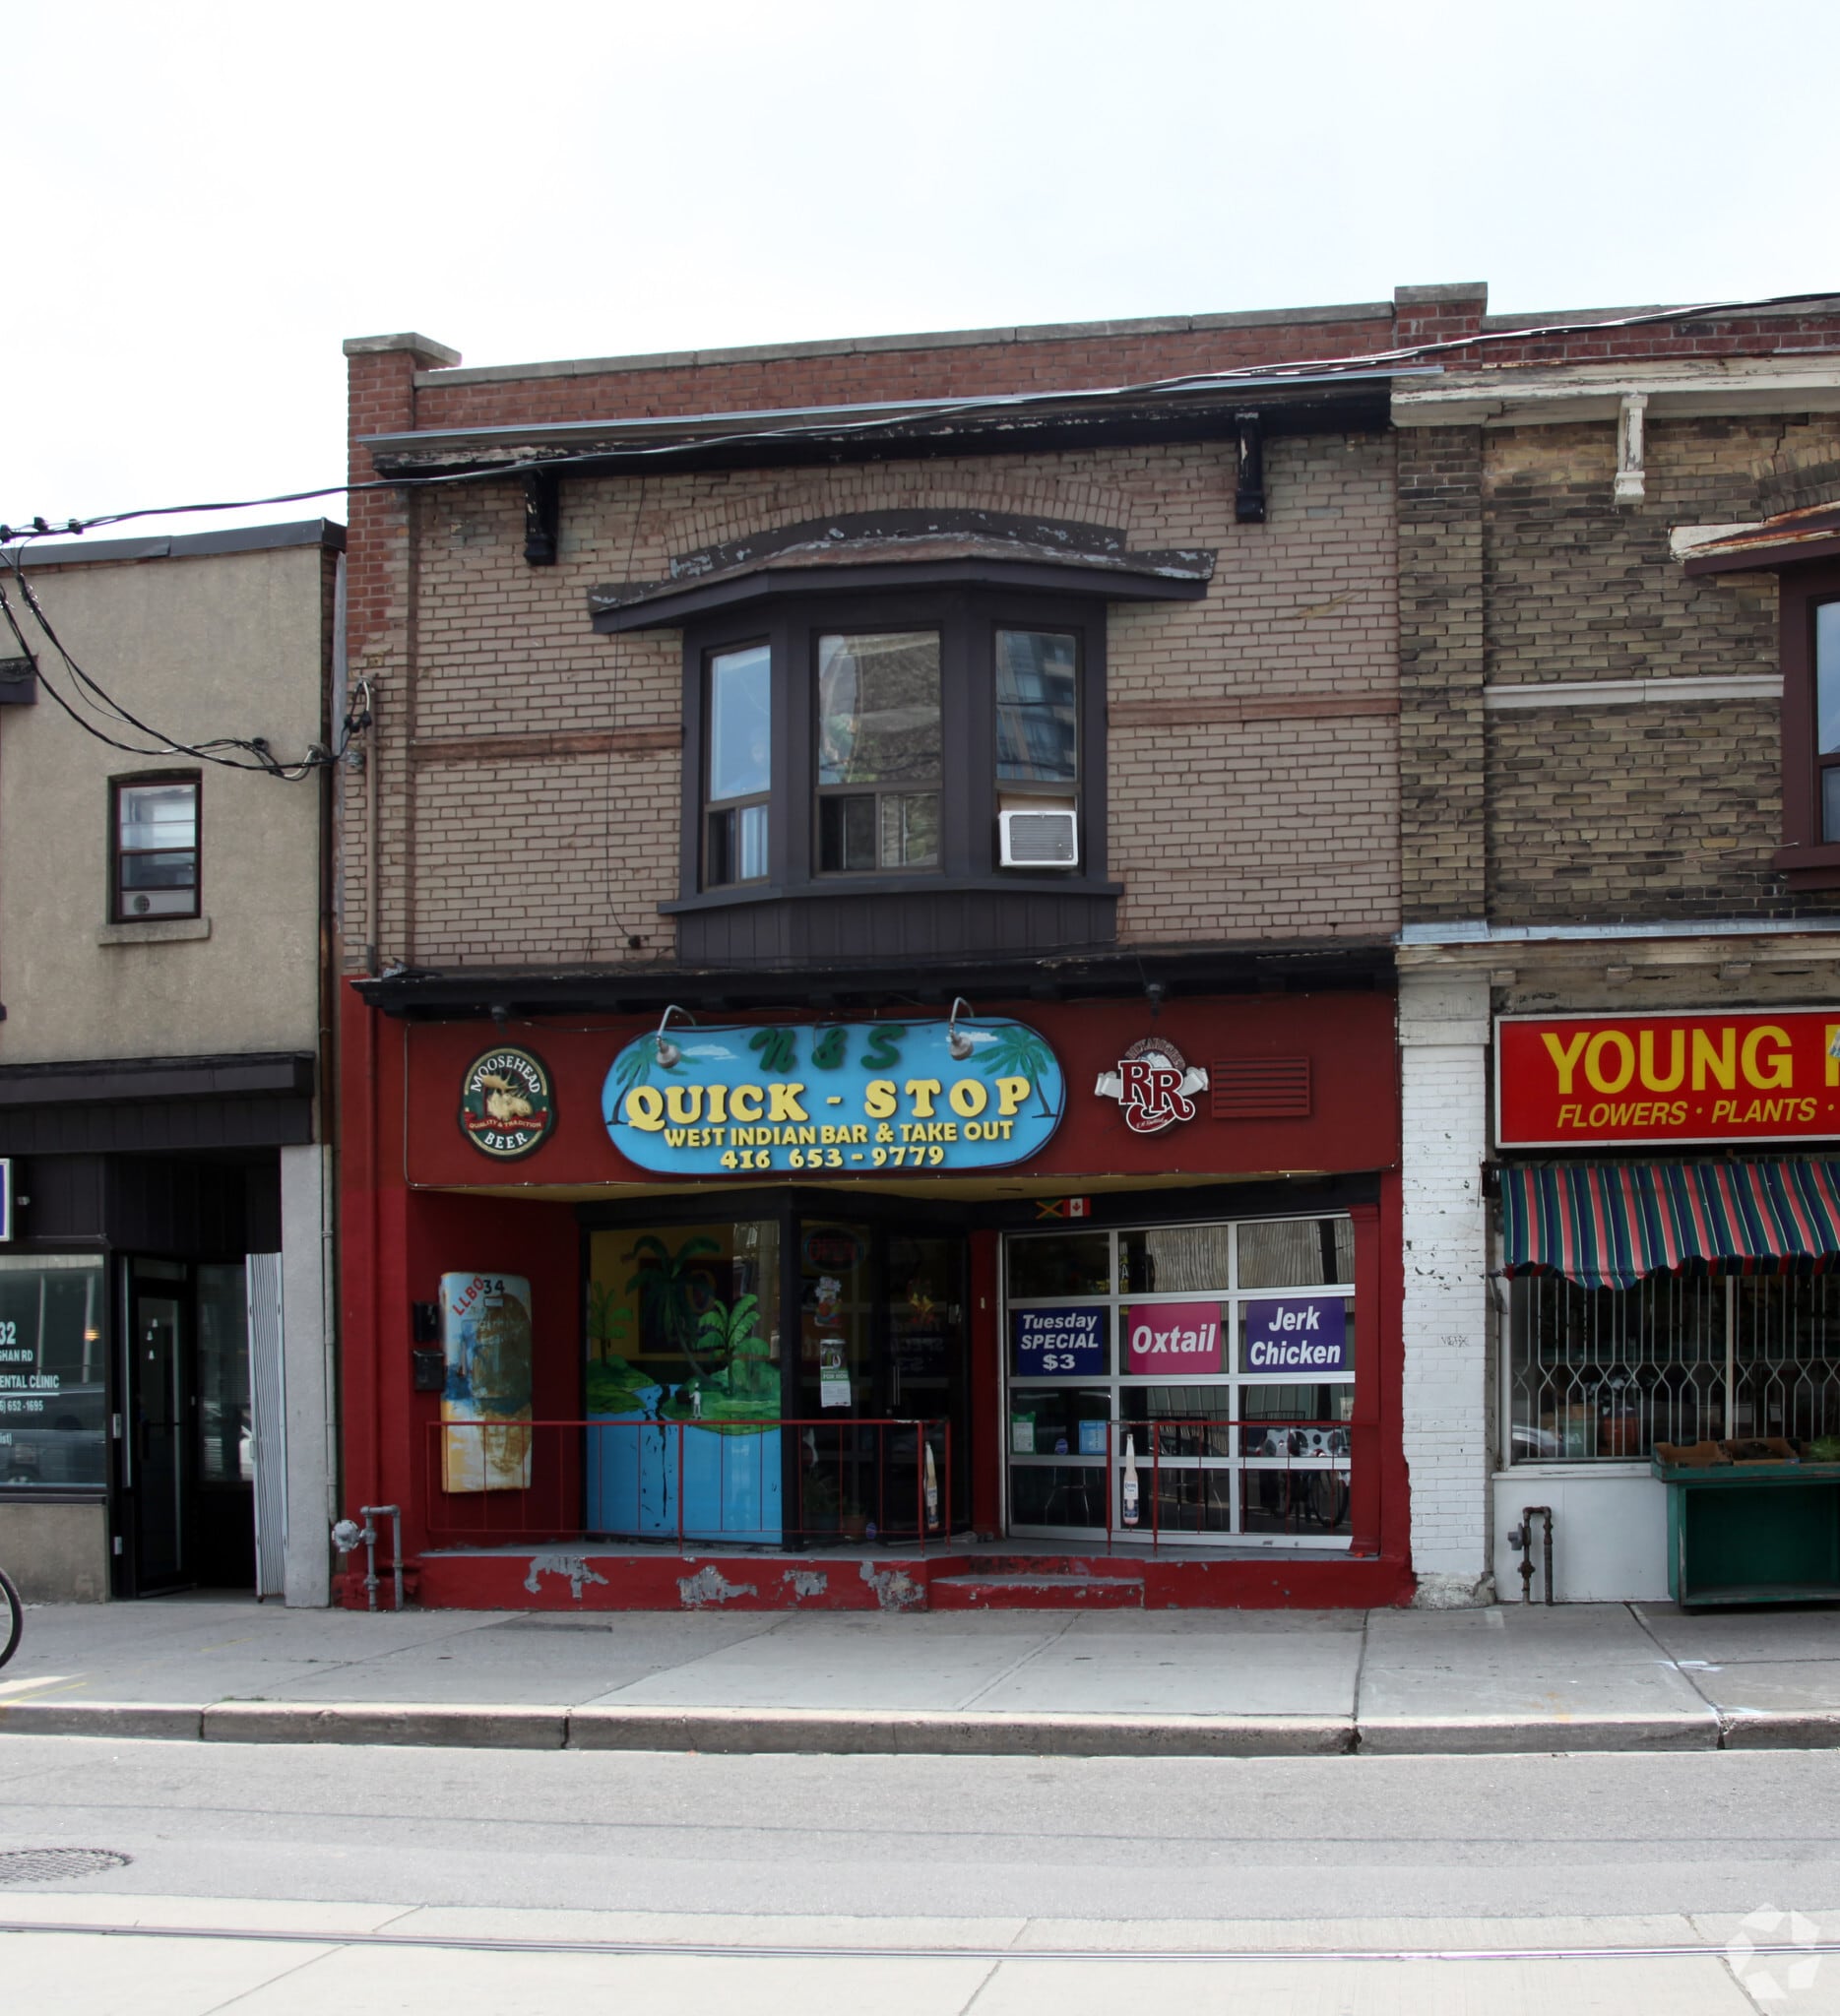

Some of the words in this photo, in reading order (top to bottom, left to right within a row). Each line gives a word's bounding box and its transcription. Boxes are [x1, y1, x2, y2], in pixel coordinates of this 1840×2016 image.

[811, 1027, 848, 1070] &
[860, 1025, 906, 1070] S
[1541, 1025, 1794, 1095] YOUNG
[470, 1055, 541, 1093] MOOSEHEAD
[625, 1083, 809, 1132] QUICK
[864, 1076, 1031, 1119] STOP
[1556, 1100, 1688, 1128] FLOWERS
[1711, 1097, 1817, 1124] PLANTS
[483, 1131, 528, 1150] BEER
[664, 1127, 726, 1148] WEST
[730, 1126, 816, 1146] INDIAN
[820, 1124, 868, 1144] BAR
[874, 1122, 894, 1143] &
[899, 1122, 957, 1142] TAKE
[963, 1120, 1014, 1141] OUT
[720, 1149, 772, 1169] 416
[789, 1147, 844, 1168] 653
[871, 1145, 945, 1166] 9779
[453, 1276, 483, 1315] LLBO
[483, 1280, 504, 1293] 34
[1022, 1313, 1098, 1331] Tuesday
[1269, 1306, 1321, 1332] Jerk
[1020, 1333, 1099, 1350] SPECIAL
[1132, 1323, 1217, 1354] Oxtail
[22, 1349, 33, 1361] RD
[1043, 1354, 1076, 1371] $3
[1249, 1341, 1342, 1366] Chicken
[30, 1374, 60, 1388] CLINIC
